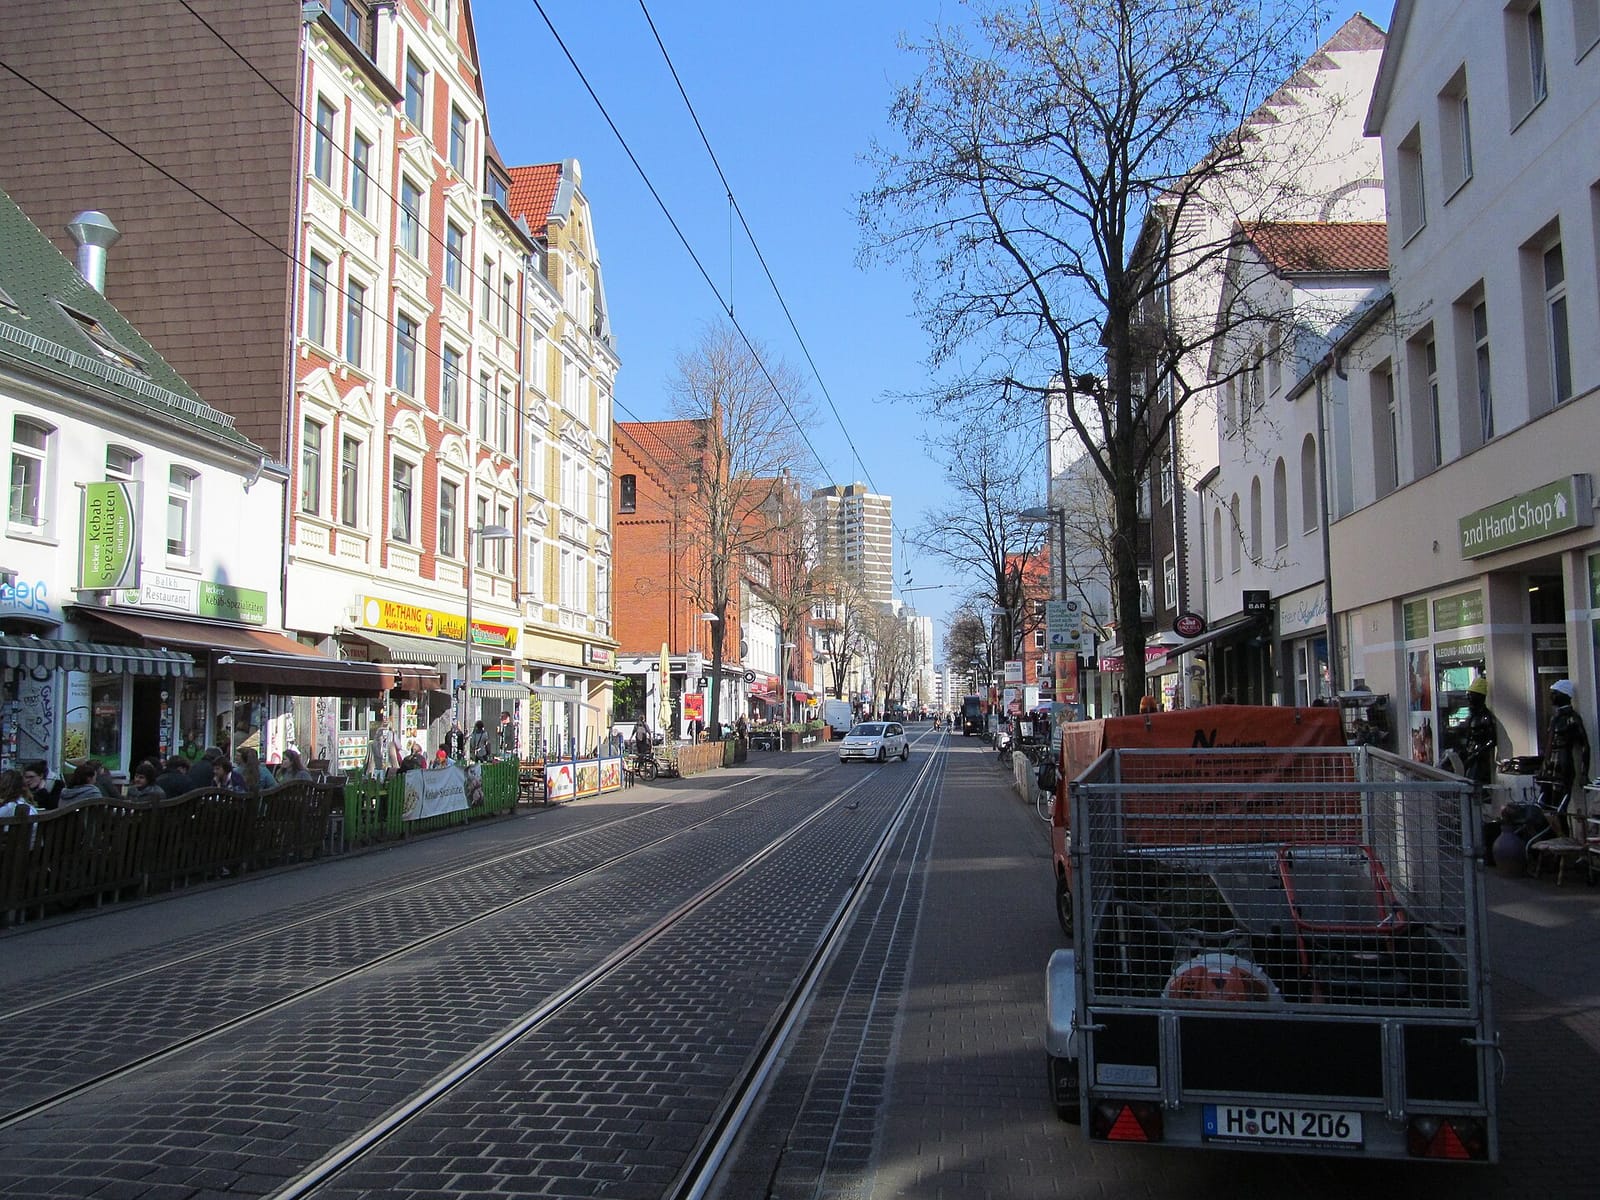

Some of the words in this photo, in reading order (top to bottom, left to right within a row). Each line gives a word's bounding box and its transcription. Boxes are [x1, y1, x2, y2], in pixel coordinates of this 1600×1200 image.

[89, 498, 102, 541] Kebab
[117, 516, 125, 537] mehr
[1463, 517, 1483, 548] 2nd
[1485, 505, 1517, 541] Hand
[1518, 501, 1552, 530] Shop
[101, 489, 116, 581] Spezialitäten
[155, 575, 179, 588] Balkh
[145, 586, 187, 604] Restaurant
[205, 595, 265, 613] Kebab-Spezialitäten
[384, 602, 422, 622] Mr.THANG
[1226, 1108, 1244, 1133] H
[1260, 1110, 1295, 1136] CN
[1301, 1112, 1350, 1139] 206
